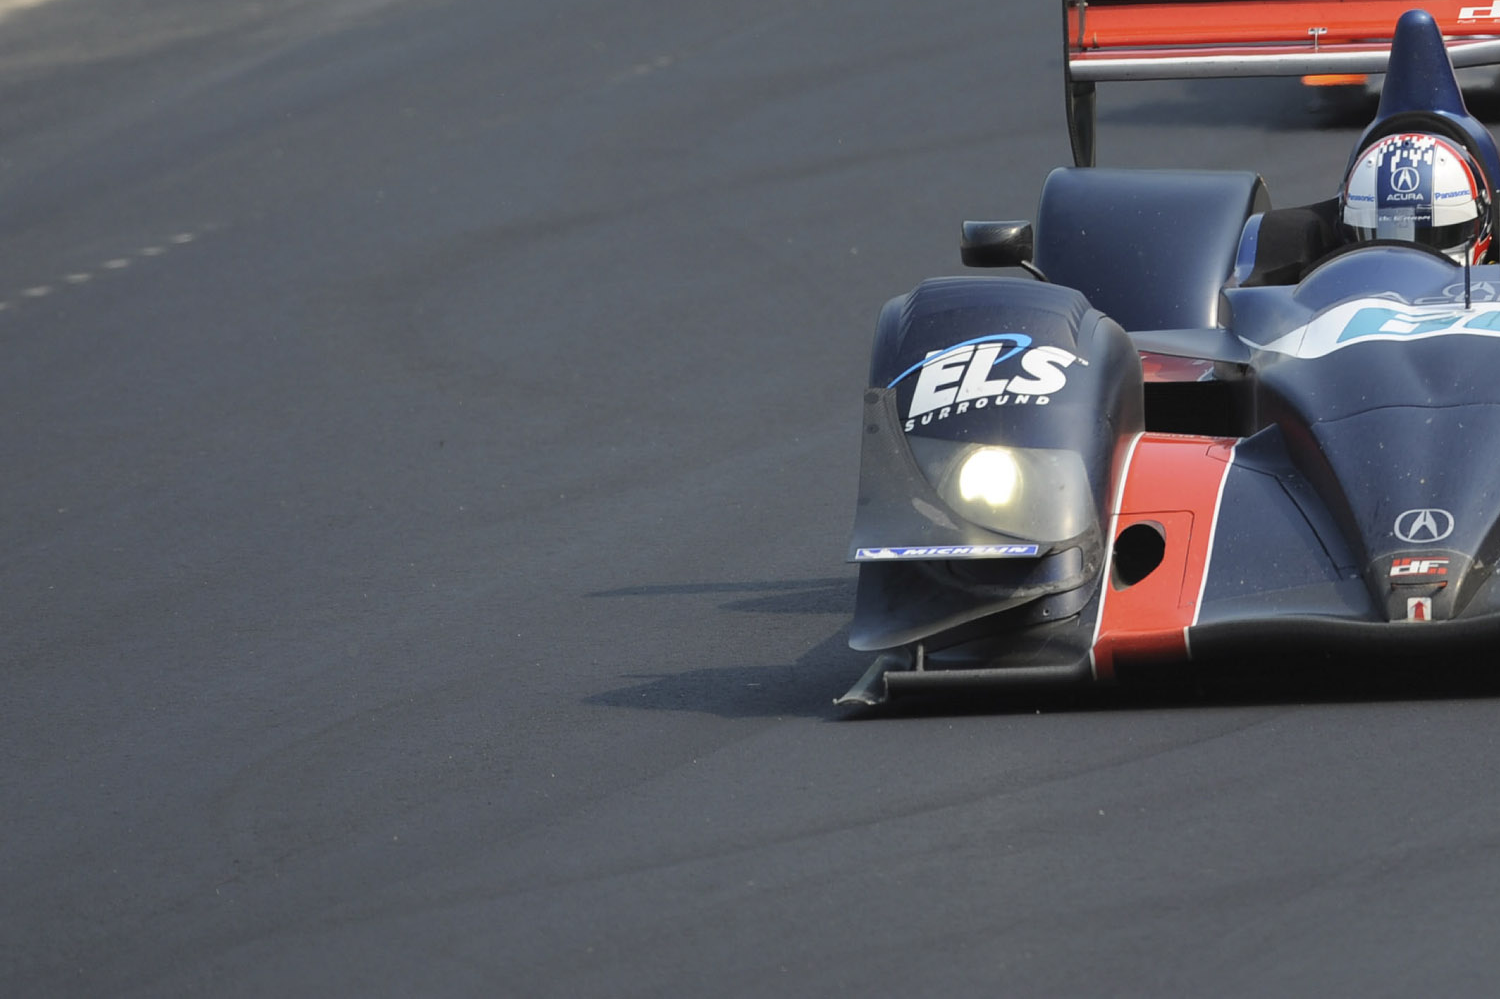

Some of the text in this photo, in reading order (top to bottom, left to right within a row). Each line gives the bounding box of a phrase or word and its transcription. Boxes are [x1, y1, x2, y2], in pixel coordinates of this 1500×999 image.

[1386, 193, 1424, 201] ACURA
[1435, 189, 1470, 199] Panasonic
[908, 343, 1077, 419] ELS
[904, 394, 1051, 433] SURROUND
[901, 545, 1029, 556] MICHELIN
